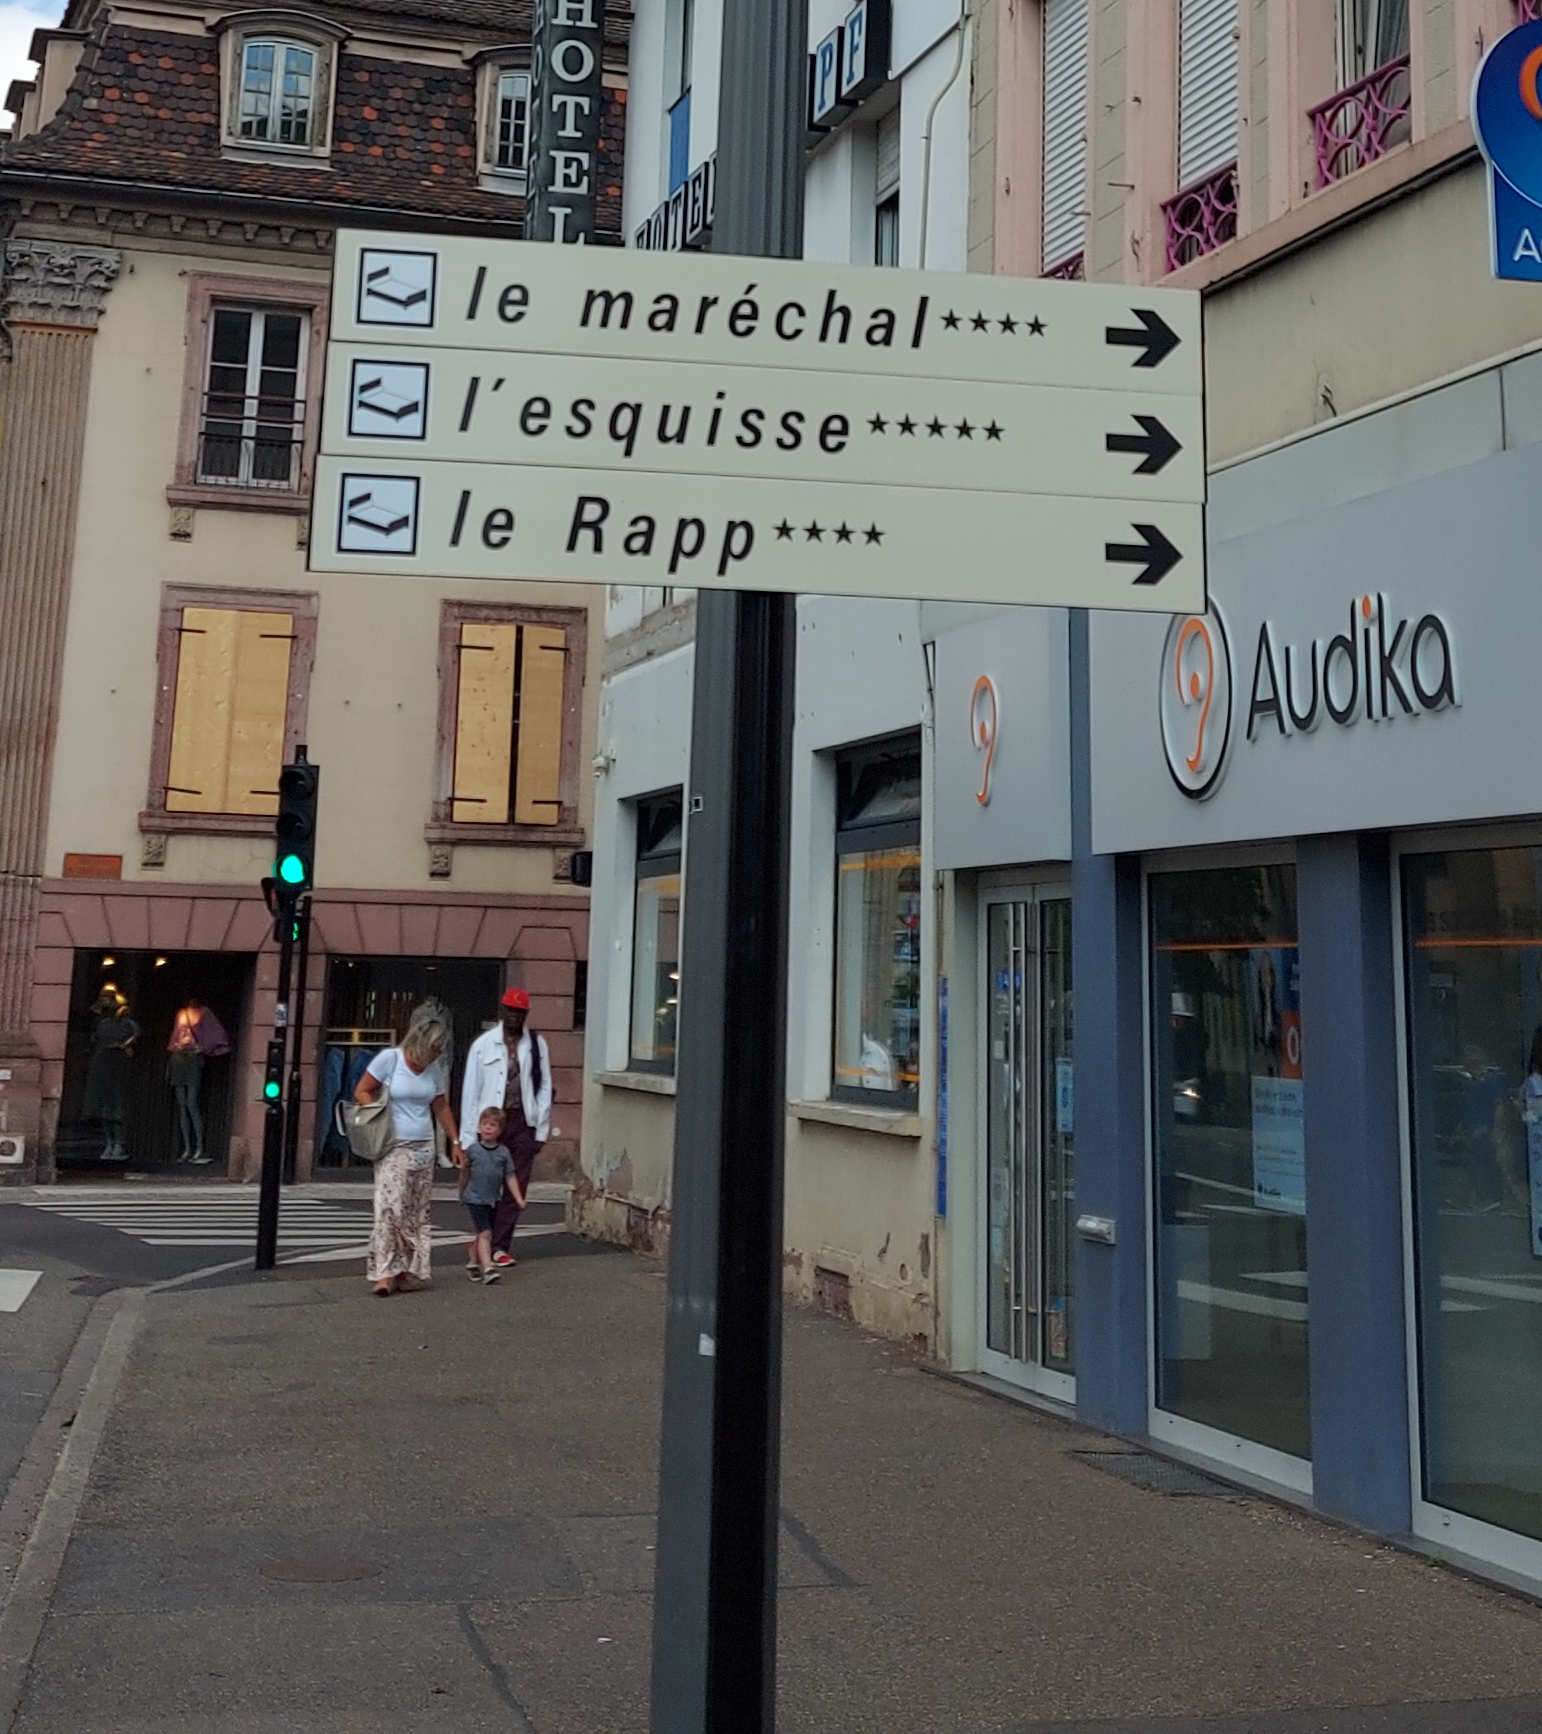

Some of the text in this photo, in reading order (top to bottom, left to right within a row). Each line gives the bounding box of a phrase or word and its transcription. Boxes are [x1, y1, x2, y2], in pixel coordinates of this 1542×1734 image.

[465, 266, 931, 350] le maréchal
[449, 490, 757, 576] le Rapp
[1247, 591, 1460, 741] Audika
